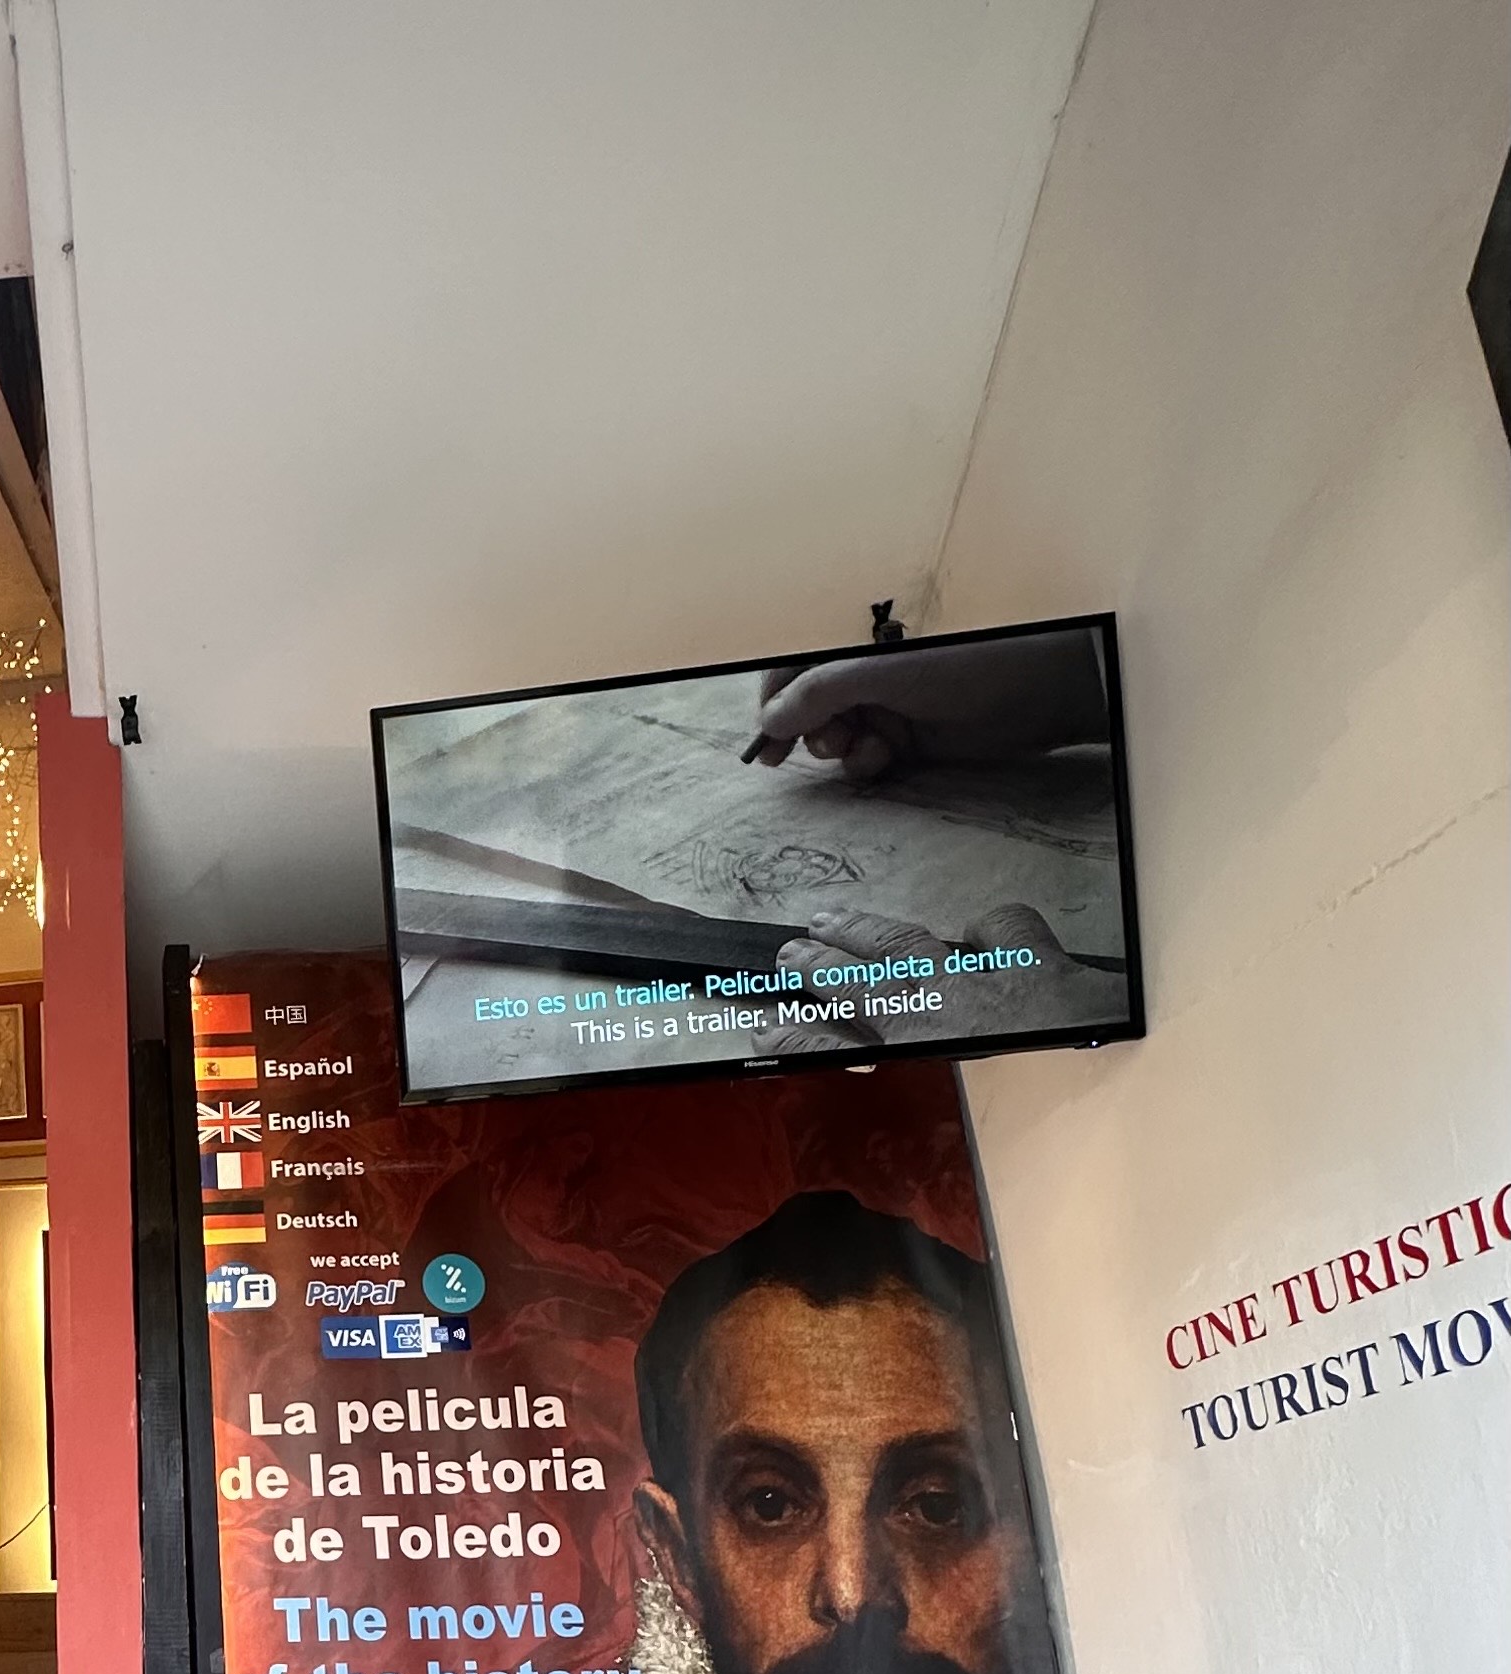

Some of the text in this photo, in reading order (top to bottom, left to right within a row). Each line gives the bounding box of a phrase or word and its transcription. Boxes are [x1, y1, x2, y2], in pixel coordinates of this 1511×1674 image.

[475, 942, 1042, 1021] Esto es un trailer. Pelicula completa dentro.
[265, 1005, 307, 1025] 中国
[571, 987, 943, 1046] This is a trailer. Movie inside
[264, 1057, 353, 1080] Español
[268, 1111, 350, 1134] English
[271, 1158, 364, 1181] Français
[276, 1210, 358, 1230] Deutsch
[310, 1252, 400, 1269] we accept
[326, 1330, 376, 1347] VISA
[1166, 1293, 1267, 1370] CINE
[248, 1386, 567, 1444] La pelicula
[1181, 1342, 1380, 1450] TOURIST
[219, 1448, 606, 1500] de la historia
[273, 1512, 561, 1562] de Toledo
[274, 1592, 585, 1642] The movie
